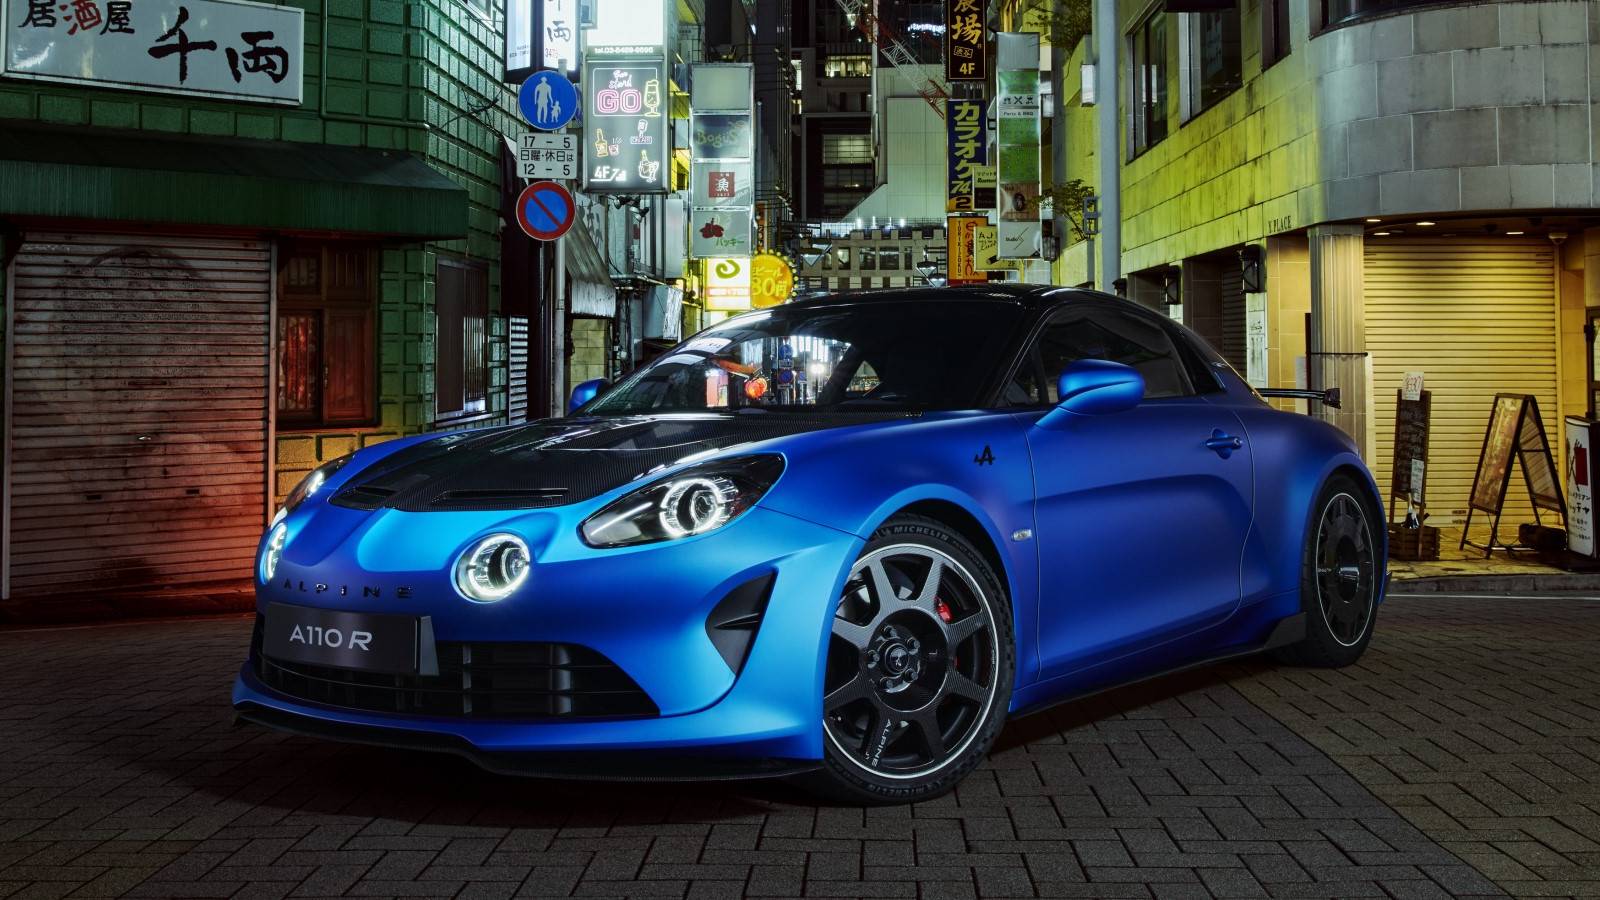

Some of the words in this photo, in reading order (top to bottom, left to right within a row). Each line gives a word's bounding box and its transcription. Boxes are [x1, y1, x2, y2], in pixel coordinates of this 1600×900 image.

[18, 0, 135, 35] 居酒屋
[148, 7, 290, 85] 千両
[959, 63, 975, 75] 4F
[597, 89, 642, 113] GO
[524, 135, 535, 147] 17
[563, 137, 571, 149] 5
[954, 102, 981, 179] カラオケ
[520, 149, 574, 162] 日曜・休日は
[523, 163, 535, 175] 12
[563, 164, 570, 176] 5
[594, 165, 612, 179] 4F
[893, 525, 949, 541] MICHELIN
[283, 578, 413, 599] ALPINE
[289, 623, 343, 648] A110
[348, 630, 374, 651] R
[871, 718, 892, 768] ALPINE
